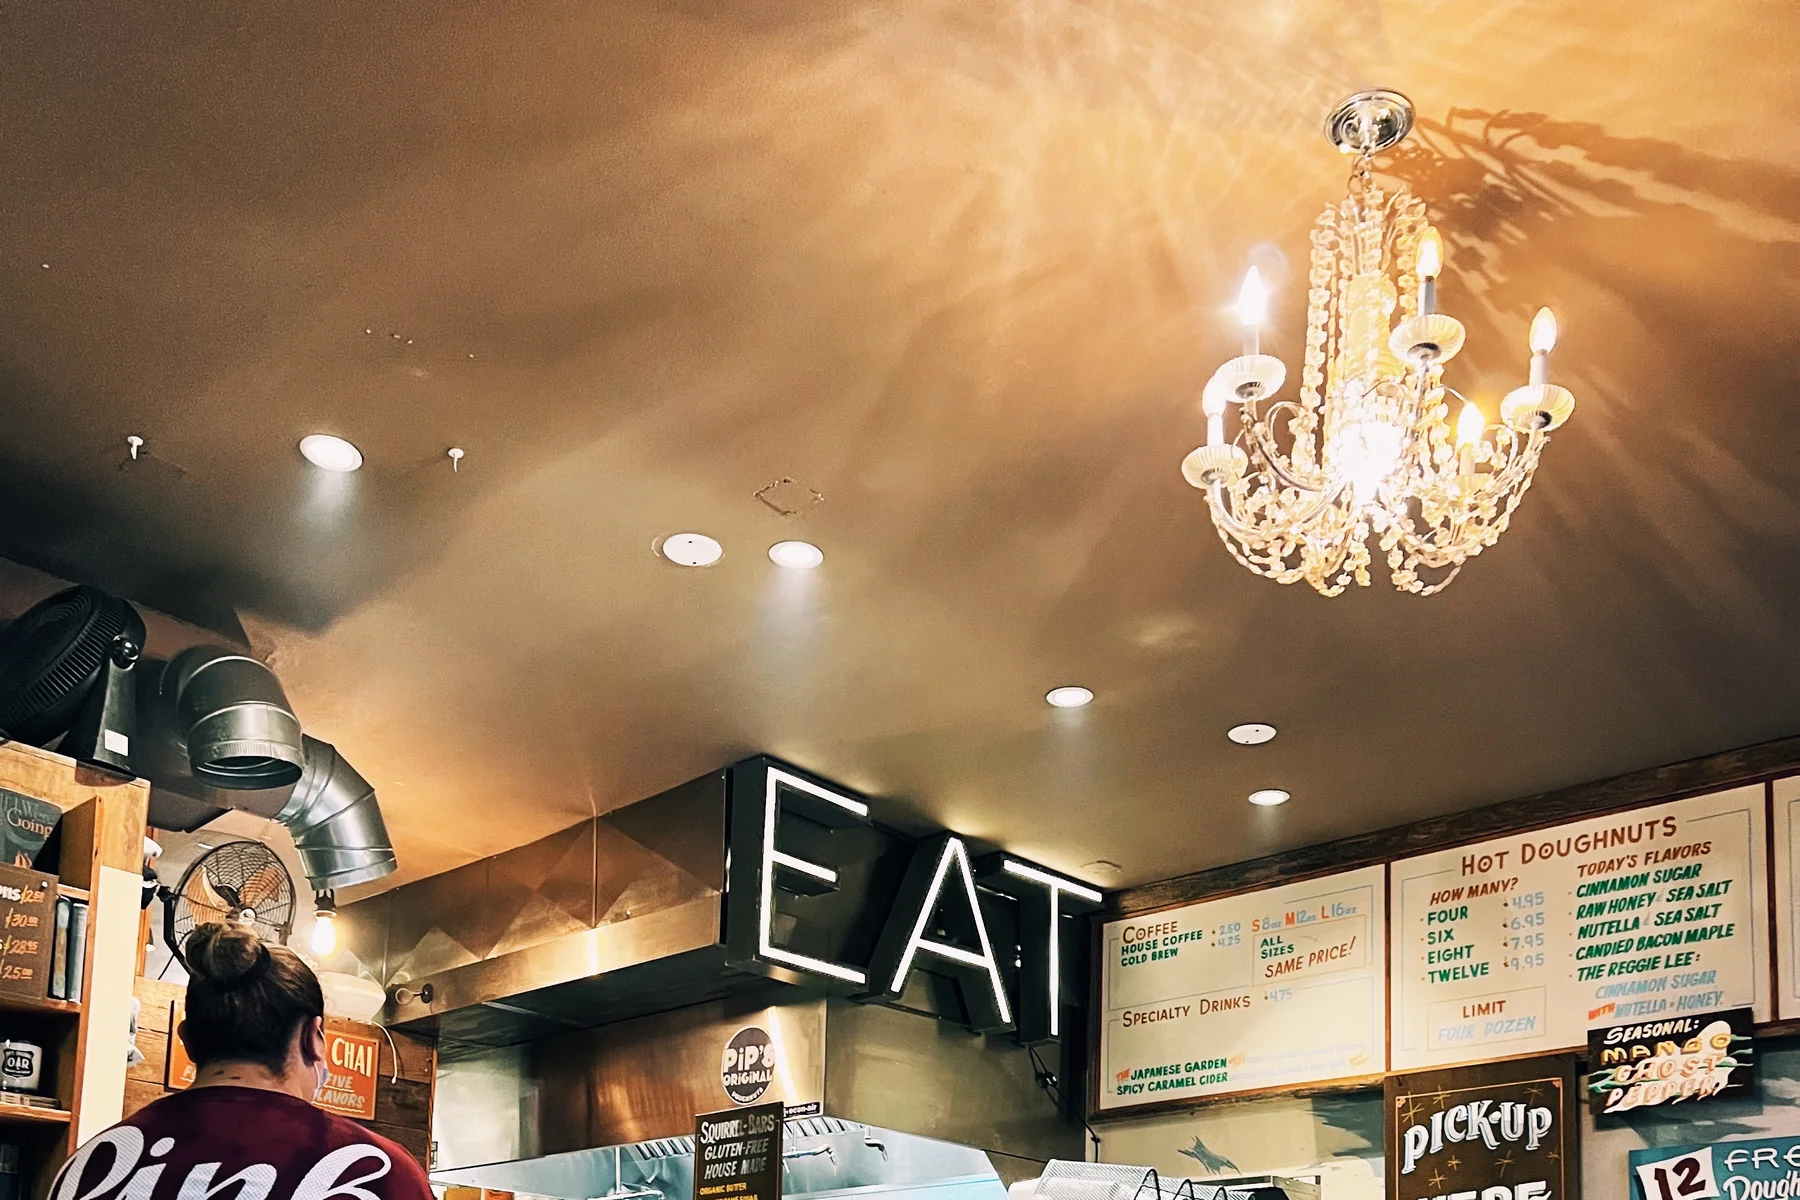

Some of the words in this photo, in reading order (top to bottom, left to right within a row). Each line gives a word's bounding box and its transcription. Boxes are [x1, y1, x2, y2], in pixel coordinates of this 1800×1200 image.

[1461, 850, 1510, 877] HOT
[1521, 816, 1677, 864] DOUGHNUTS
[1577, 854, 1638, 878] TODAY'S
[1644, 841, 1712, 865] FLAVORS
[1429, 886, 1465, 906] HOW
[1467, 876, 1519, 899] MANY?
[1576, 871, 1650, 898] CINNAMON
[1653, 863, 1702, 885] SUGAR
[759, 766, 1102, 1036] EAT
[1576, 901, 1607, 920] RAW
[1608, 891, 1657, 914] HONEY
[1666, 886, 1695, 903] SEA
[1696, 879, 1733, 898] SALT
[1251, 919, 1260, 932] S
[1285, 912, 1295, 926] M
[1321, 906, 1329, 919] L
[1427, 905, 1469, 926] FOUR
[1577, 916, 1640, 940] NUTELLA
[1654, 909, 1682, 927] SEA
[1684, 903, 1722, 922] SALT
[1121, 939, 1158, 956] HOUSE
[1162, 930, 1203, 946] COFFEE
[1122, 921, 1178, 944] COFFEE
[1260, 935, 1283, 948] ALL
[1427, 928, 1455, 945] SIX
[1576, 938, 1634, 961] CANDIED
[1636, 930, 1683, 952] BACON
[1684, 923, 1735, 944] MAPLE
[1121, 954, 1147, 967] COLD
[1151, 947, 1179, 961] BREW
[1261, 943, 1295, 960] SIZES
[1265, 955, 1304, 978] SAME
[1308, 936, 1356, 967] PRICE!
[1427, 944, 1475, 965] EIGHT
[1428, 962, 1490, 984] TWELVE
[1577, 963, 1606, 982] THE
[1608, 956, 1661, 977] REGGIE
[1595, 976, 1667, 999] CINNAMON
[1671, 970, 1717, 989] SUGAR
[1122, 1005, 1191, 1028] SPECIALTY
[1200, 995, 1251, 1015] DRINKS
[1462, 1000, 1506, 1019] LIMIT
[1613, 998, 1667, 1019] NUTELLA
[1437, 1024, 1475, 1041] FOUR
[1484, 1015, 1537, 1036] DOZEN
[1603, 1018, 1700, 1045] SEASONAL:
[331, 1037, 373, 1077] CHAI
[1601, 1033, 1733, 1065] MANGO
[1130, 1063, 1181, 1081] JAPANESE
[1184, 1057, 1228, 1073] GARDEN
[1614, 1053, 1724, 1082] GHOST
[1116, 1083, 1145, 1096] SPICY
[1147, 1076, 1197, 1092] CARAMEL
[1199, 1071, 1228, 1086] CIDER
[1605, 1076, 1716, 1106] PEPPER
[317, 1090, 365, 1108] LAVORS
[704, 1138, 769, 1160] GLUTEN-FREE
[704, 1161, 737, 1179] HOUSE
[740, 1157, 767, 1175] MADE
[700, 1185, 725, 1195] ORGANIC
[726, 1182, 747, 1192] BUTTER
